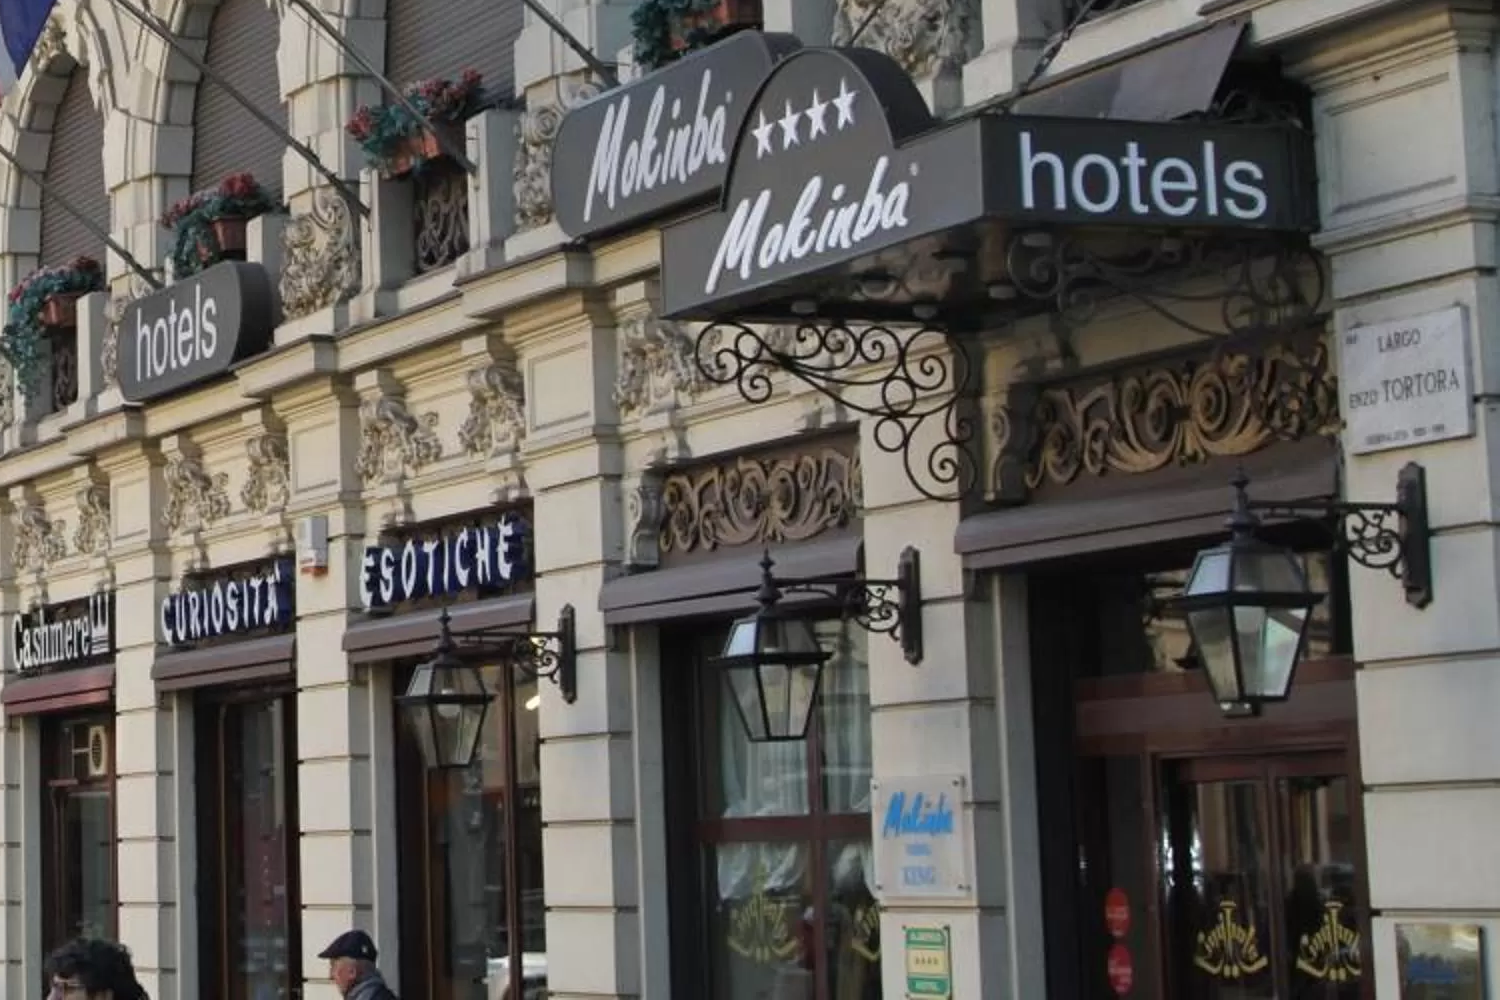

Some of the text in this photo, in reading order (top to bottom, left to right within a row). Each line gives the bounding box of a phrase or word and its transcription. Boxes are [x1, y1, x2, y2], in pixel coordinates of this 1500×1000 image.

[1019, 131, 1267, 219] hotels
[136, 283, 218, 382] hotels
[1376, 328, 1421, 353] LARGO
[1381, 367, 1460, 403] TORTORA
[359, 512, 514, 613] ESOTICHE
[11, 608, 90, 674] Cashmere
